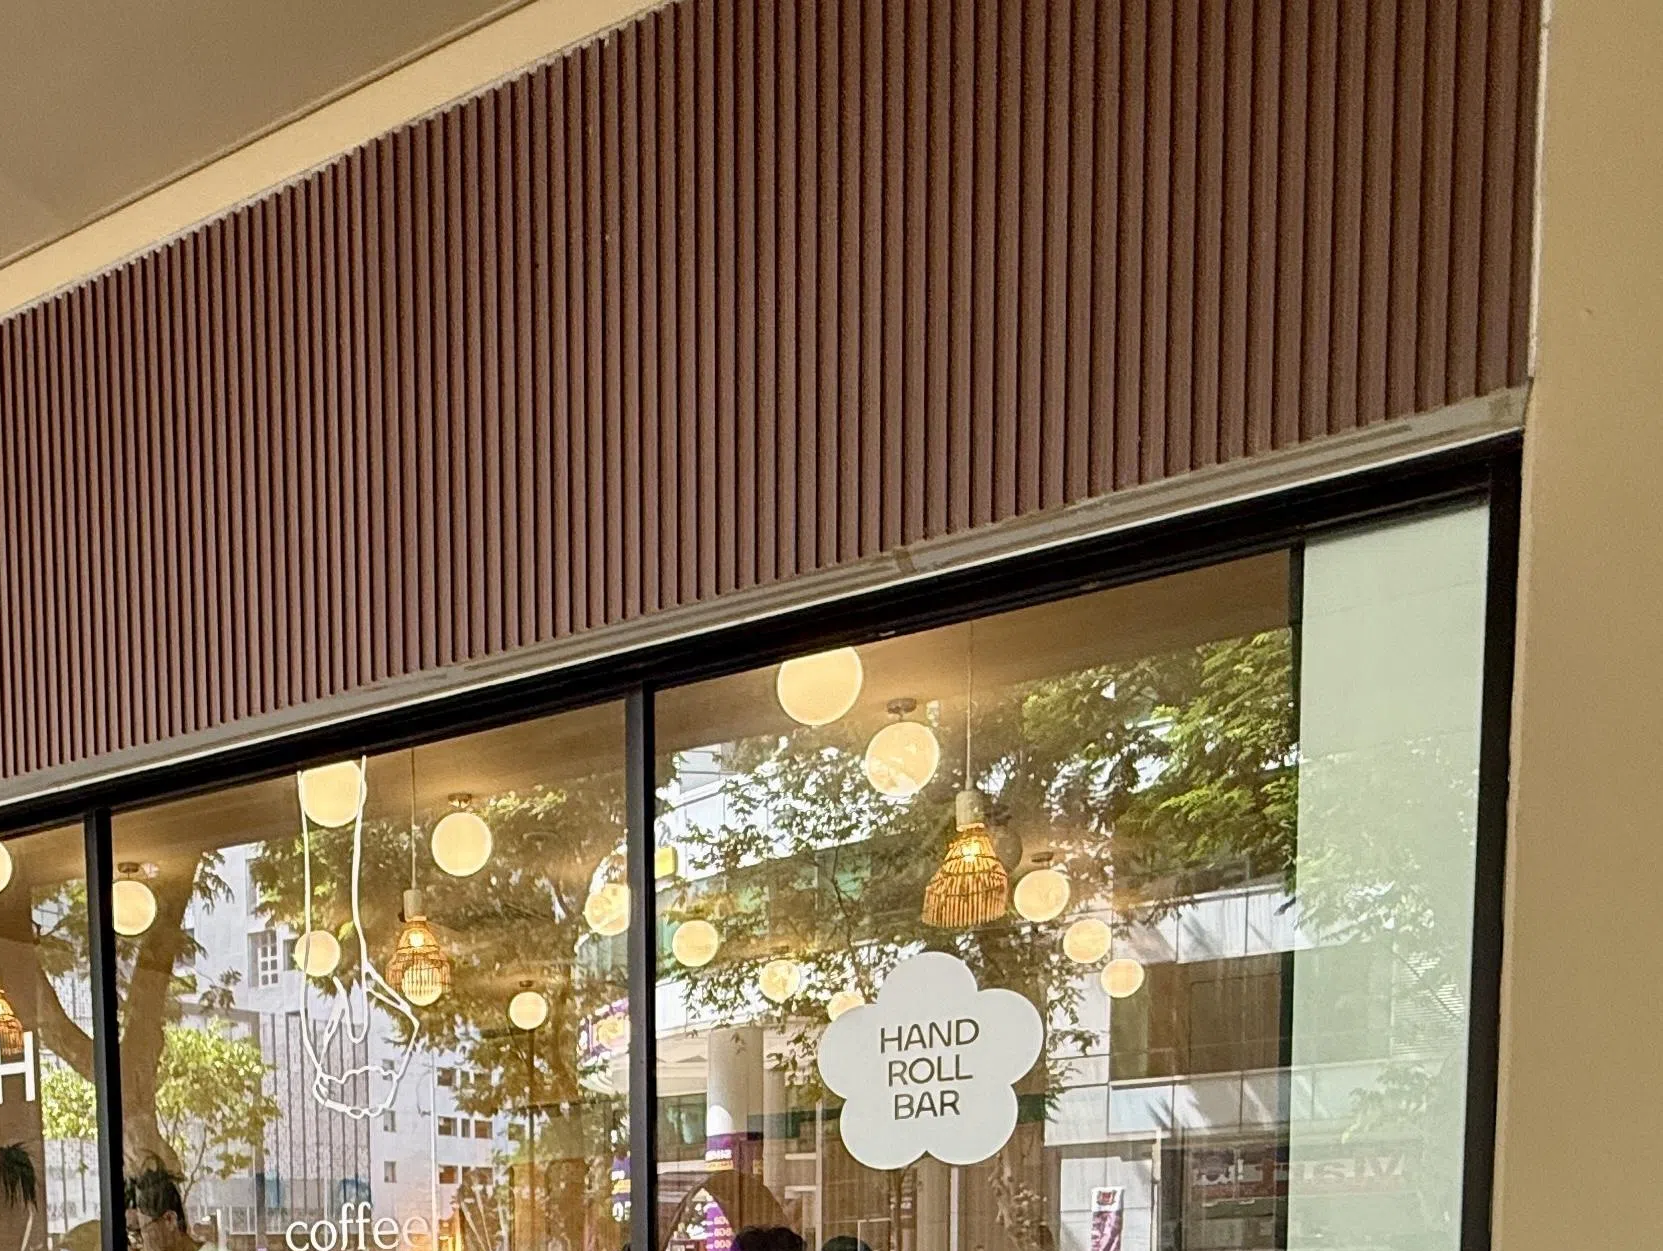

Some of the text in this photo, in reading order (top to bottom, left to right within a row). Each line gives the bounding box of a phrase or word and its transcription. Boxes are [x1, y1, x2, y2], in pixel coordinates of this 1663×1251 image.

[880, 1018, 979, 1054] HAND
[888, 1054, 973, 1087] ROLL
[894, 1090, 960, 1120] BAR
